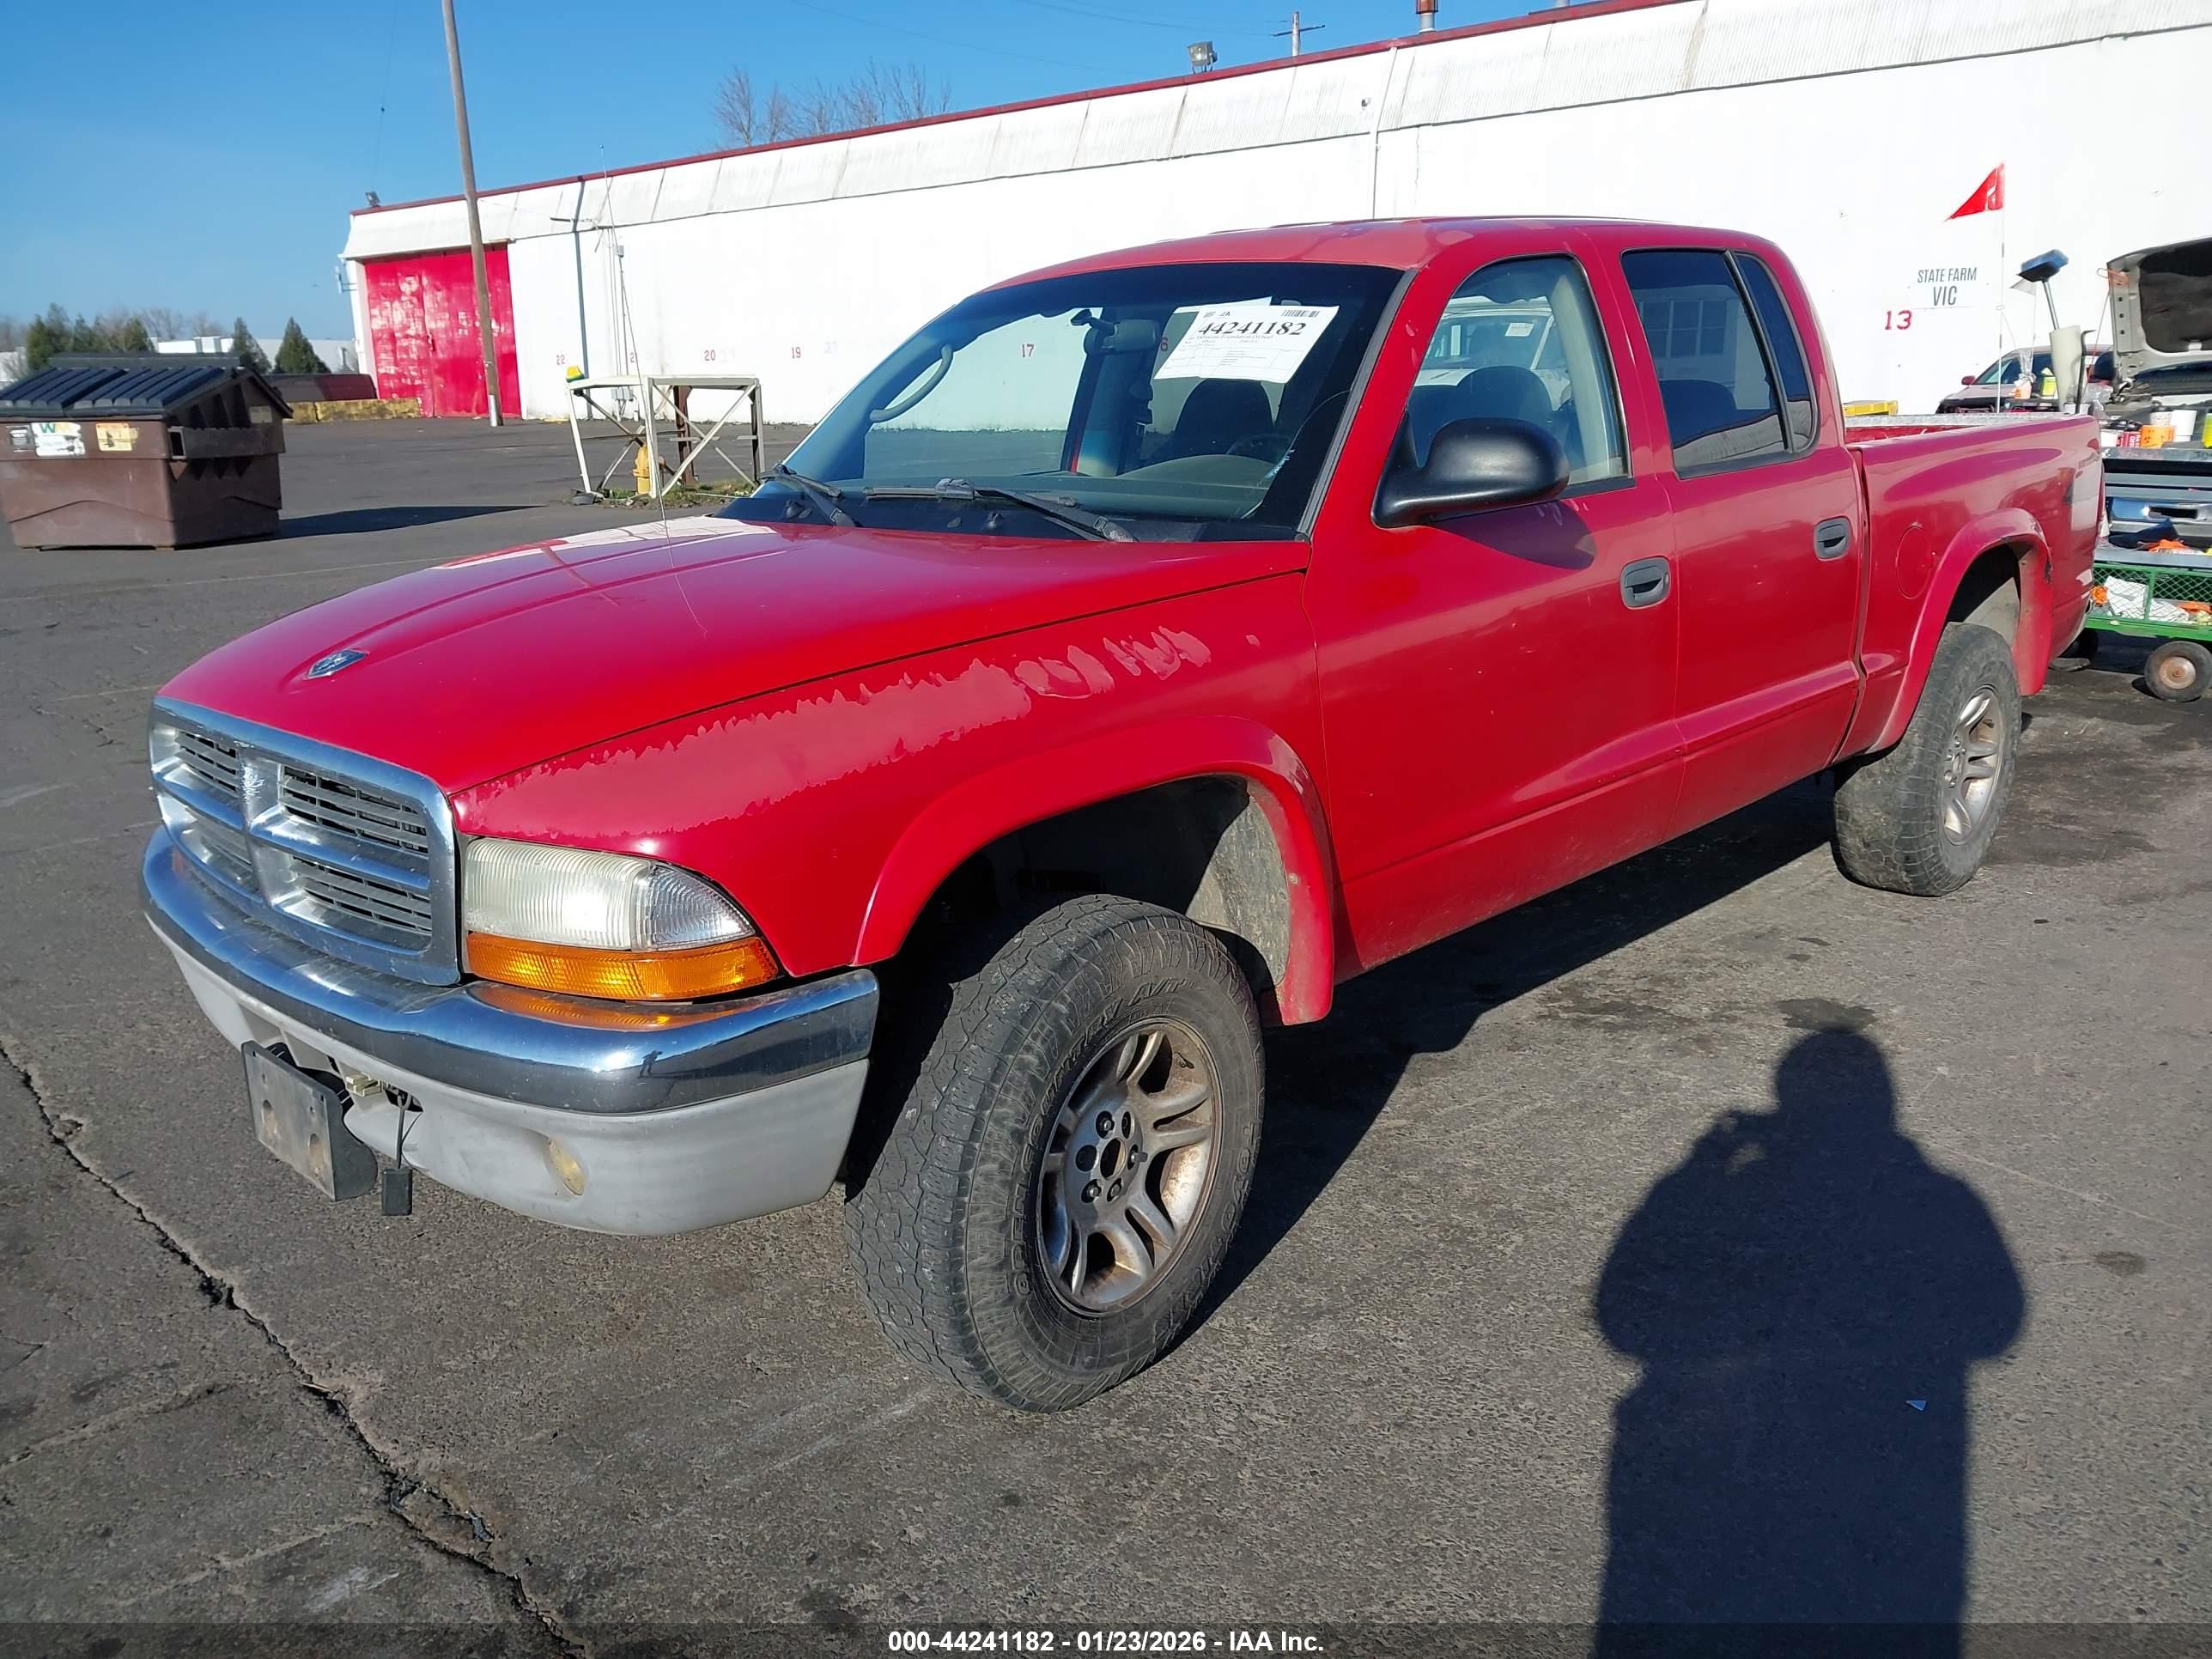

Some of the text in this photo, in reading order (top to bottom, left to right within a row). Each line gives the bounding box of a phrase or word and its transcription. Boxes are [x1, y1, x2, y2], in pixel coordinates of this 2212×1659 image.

[1917, 267, 1977, 283] STATE FARM
[1933, 285, 1958, 306] VIC
[1199, 320, 1307, 336] 44241182
[1884, 309, 1912, 331] 13
[703, 349, 716, 362] 20
[792, 346, 801, 359] 19
[1022, 343, 1035, 357] 17
[1012, 1182, 1031, 1296] OPEN
